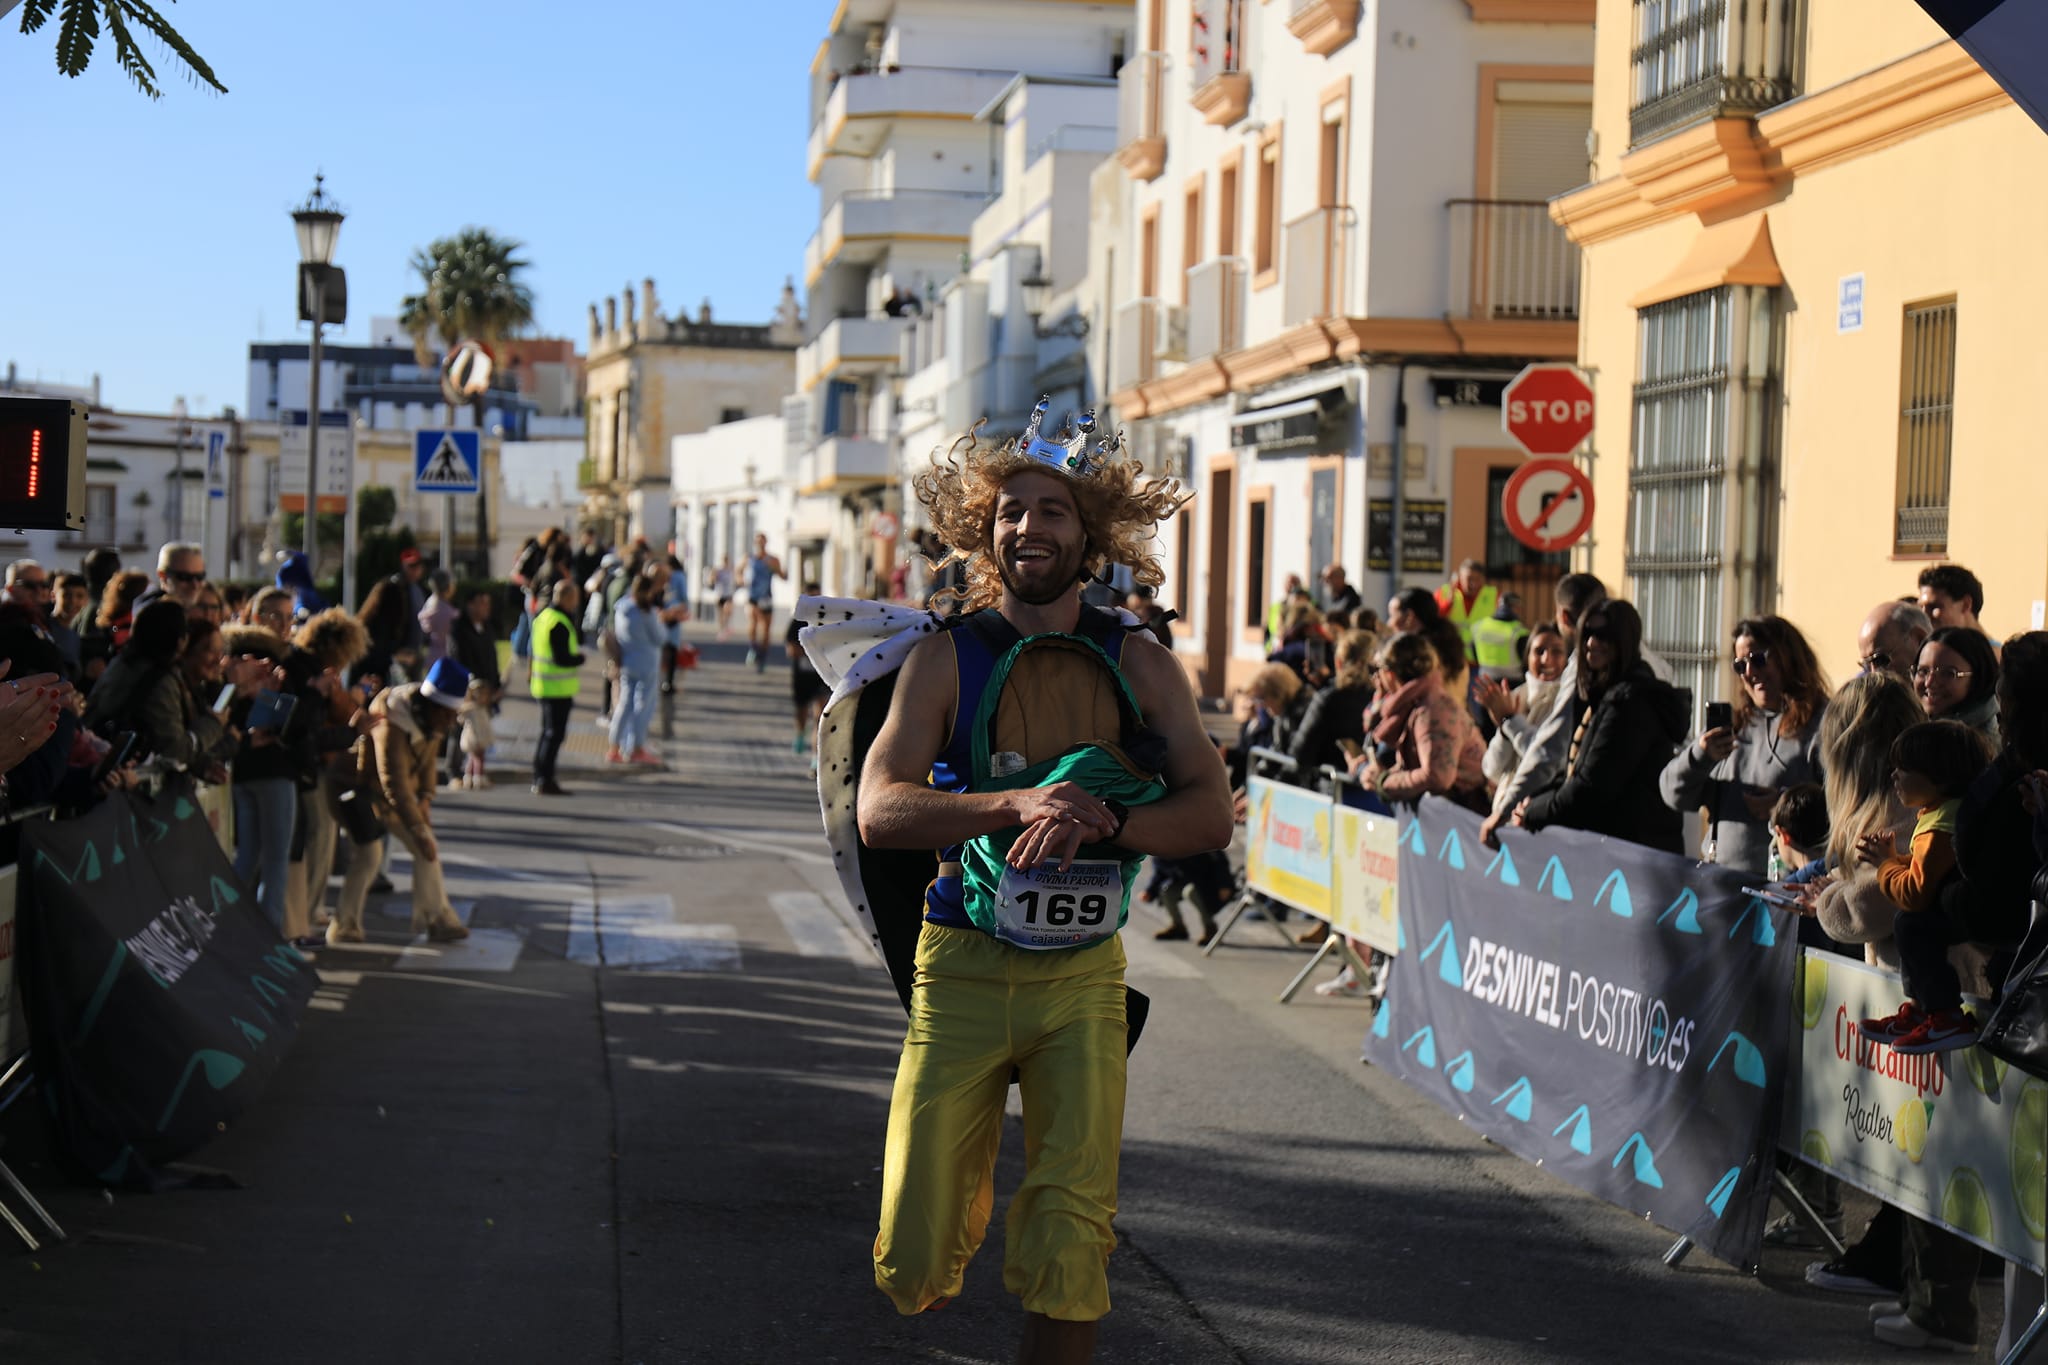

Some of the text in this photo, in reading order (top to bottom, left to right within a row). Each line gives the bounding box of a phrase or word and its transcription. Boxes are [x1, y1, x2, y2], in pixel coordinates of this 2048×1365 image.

[1510, 400, 1592, 424] STOP
[1035, 872, 1067, 884] DIVINA
[1069, 875, 1110, 887] PASTORA
[1015, 890, 1107, 926] 169
[1031, 934, 1072, 944] cajasur
[1835, 1000, 1944, 1098] Cruzcampo
[1843, 1083, 1893, 1144] Radler
